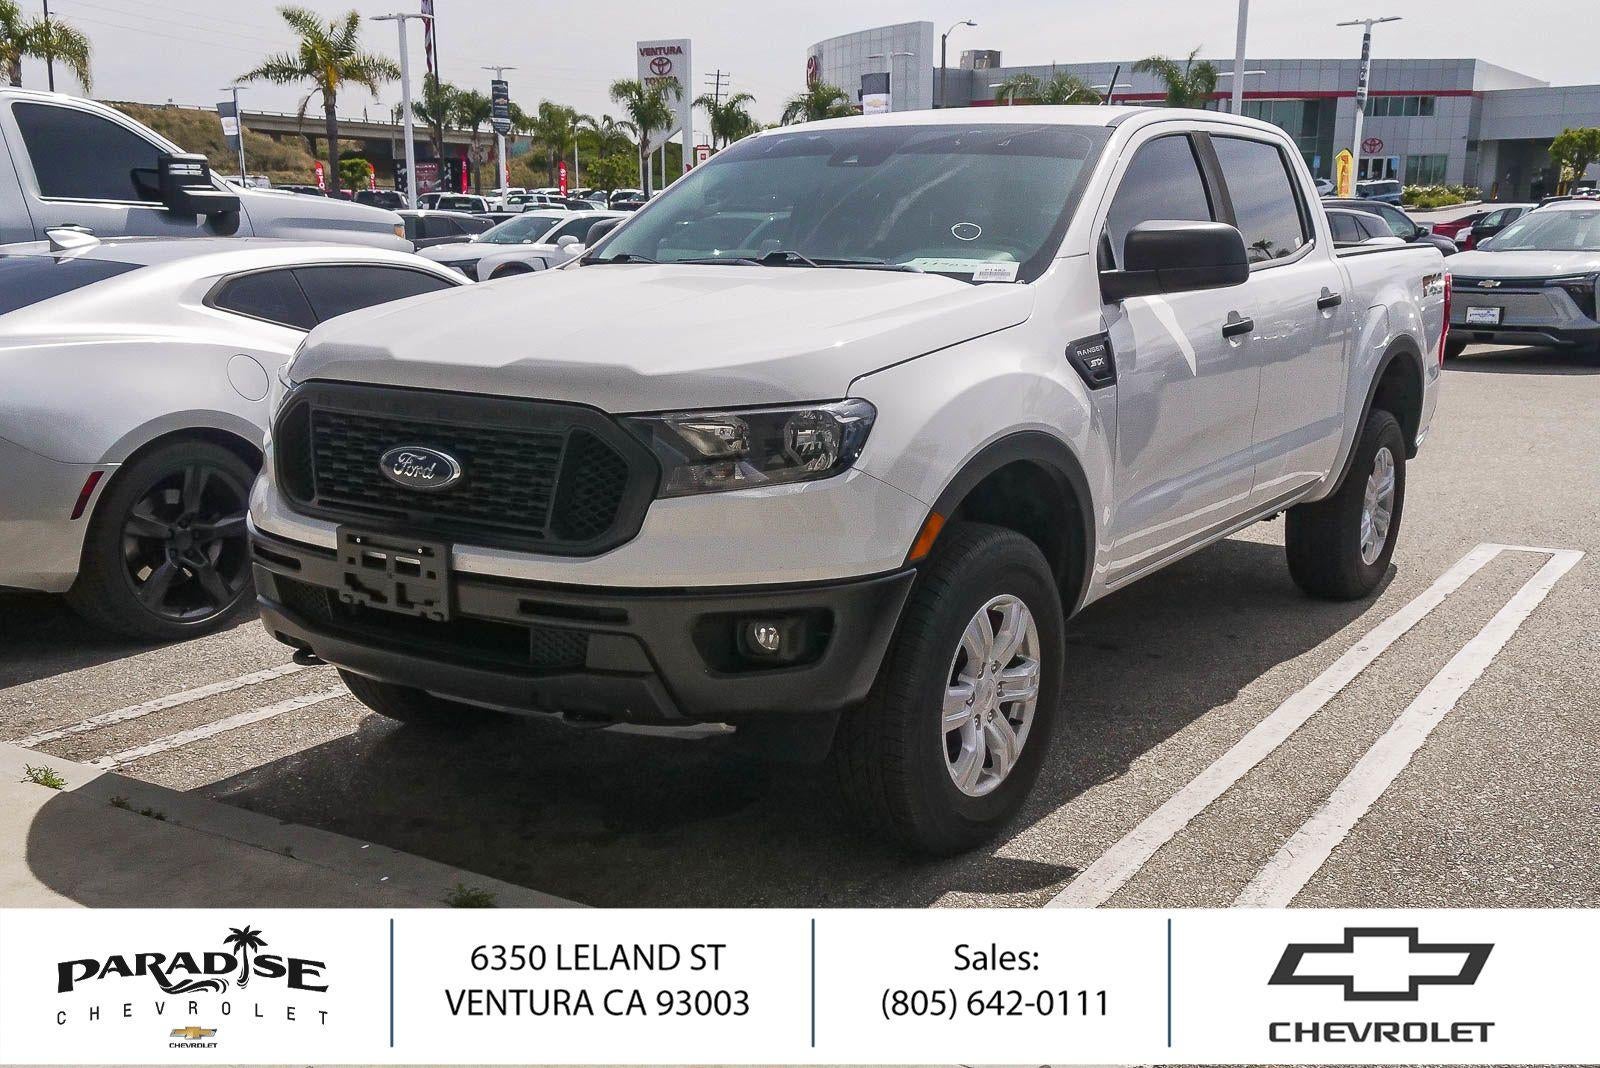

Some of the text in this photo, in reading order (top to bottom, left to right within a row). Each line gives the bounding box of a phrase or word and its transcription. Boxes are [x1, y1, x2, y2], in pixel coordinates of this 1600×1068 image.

[639, 46, 683, 56] VENTURA
[1076, 344, 1105, 357] RANGER
[1090, 357, 1105, 368] STX
[393, 452, 437, 480] Ford
